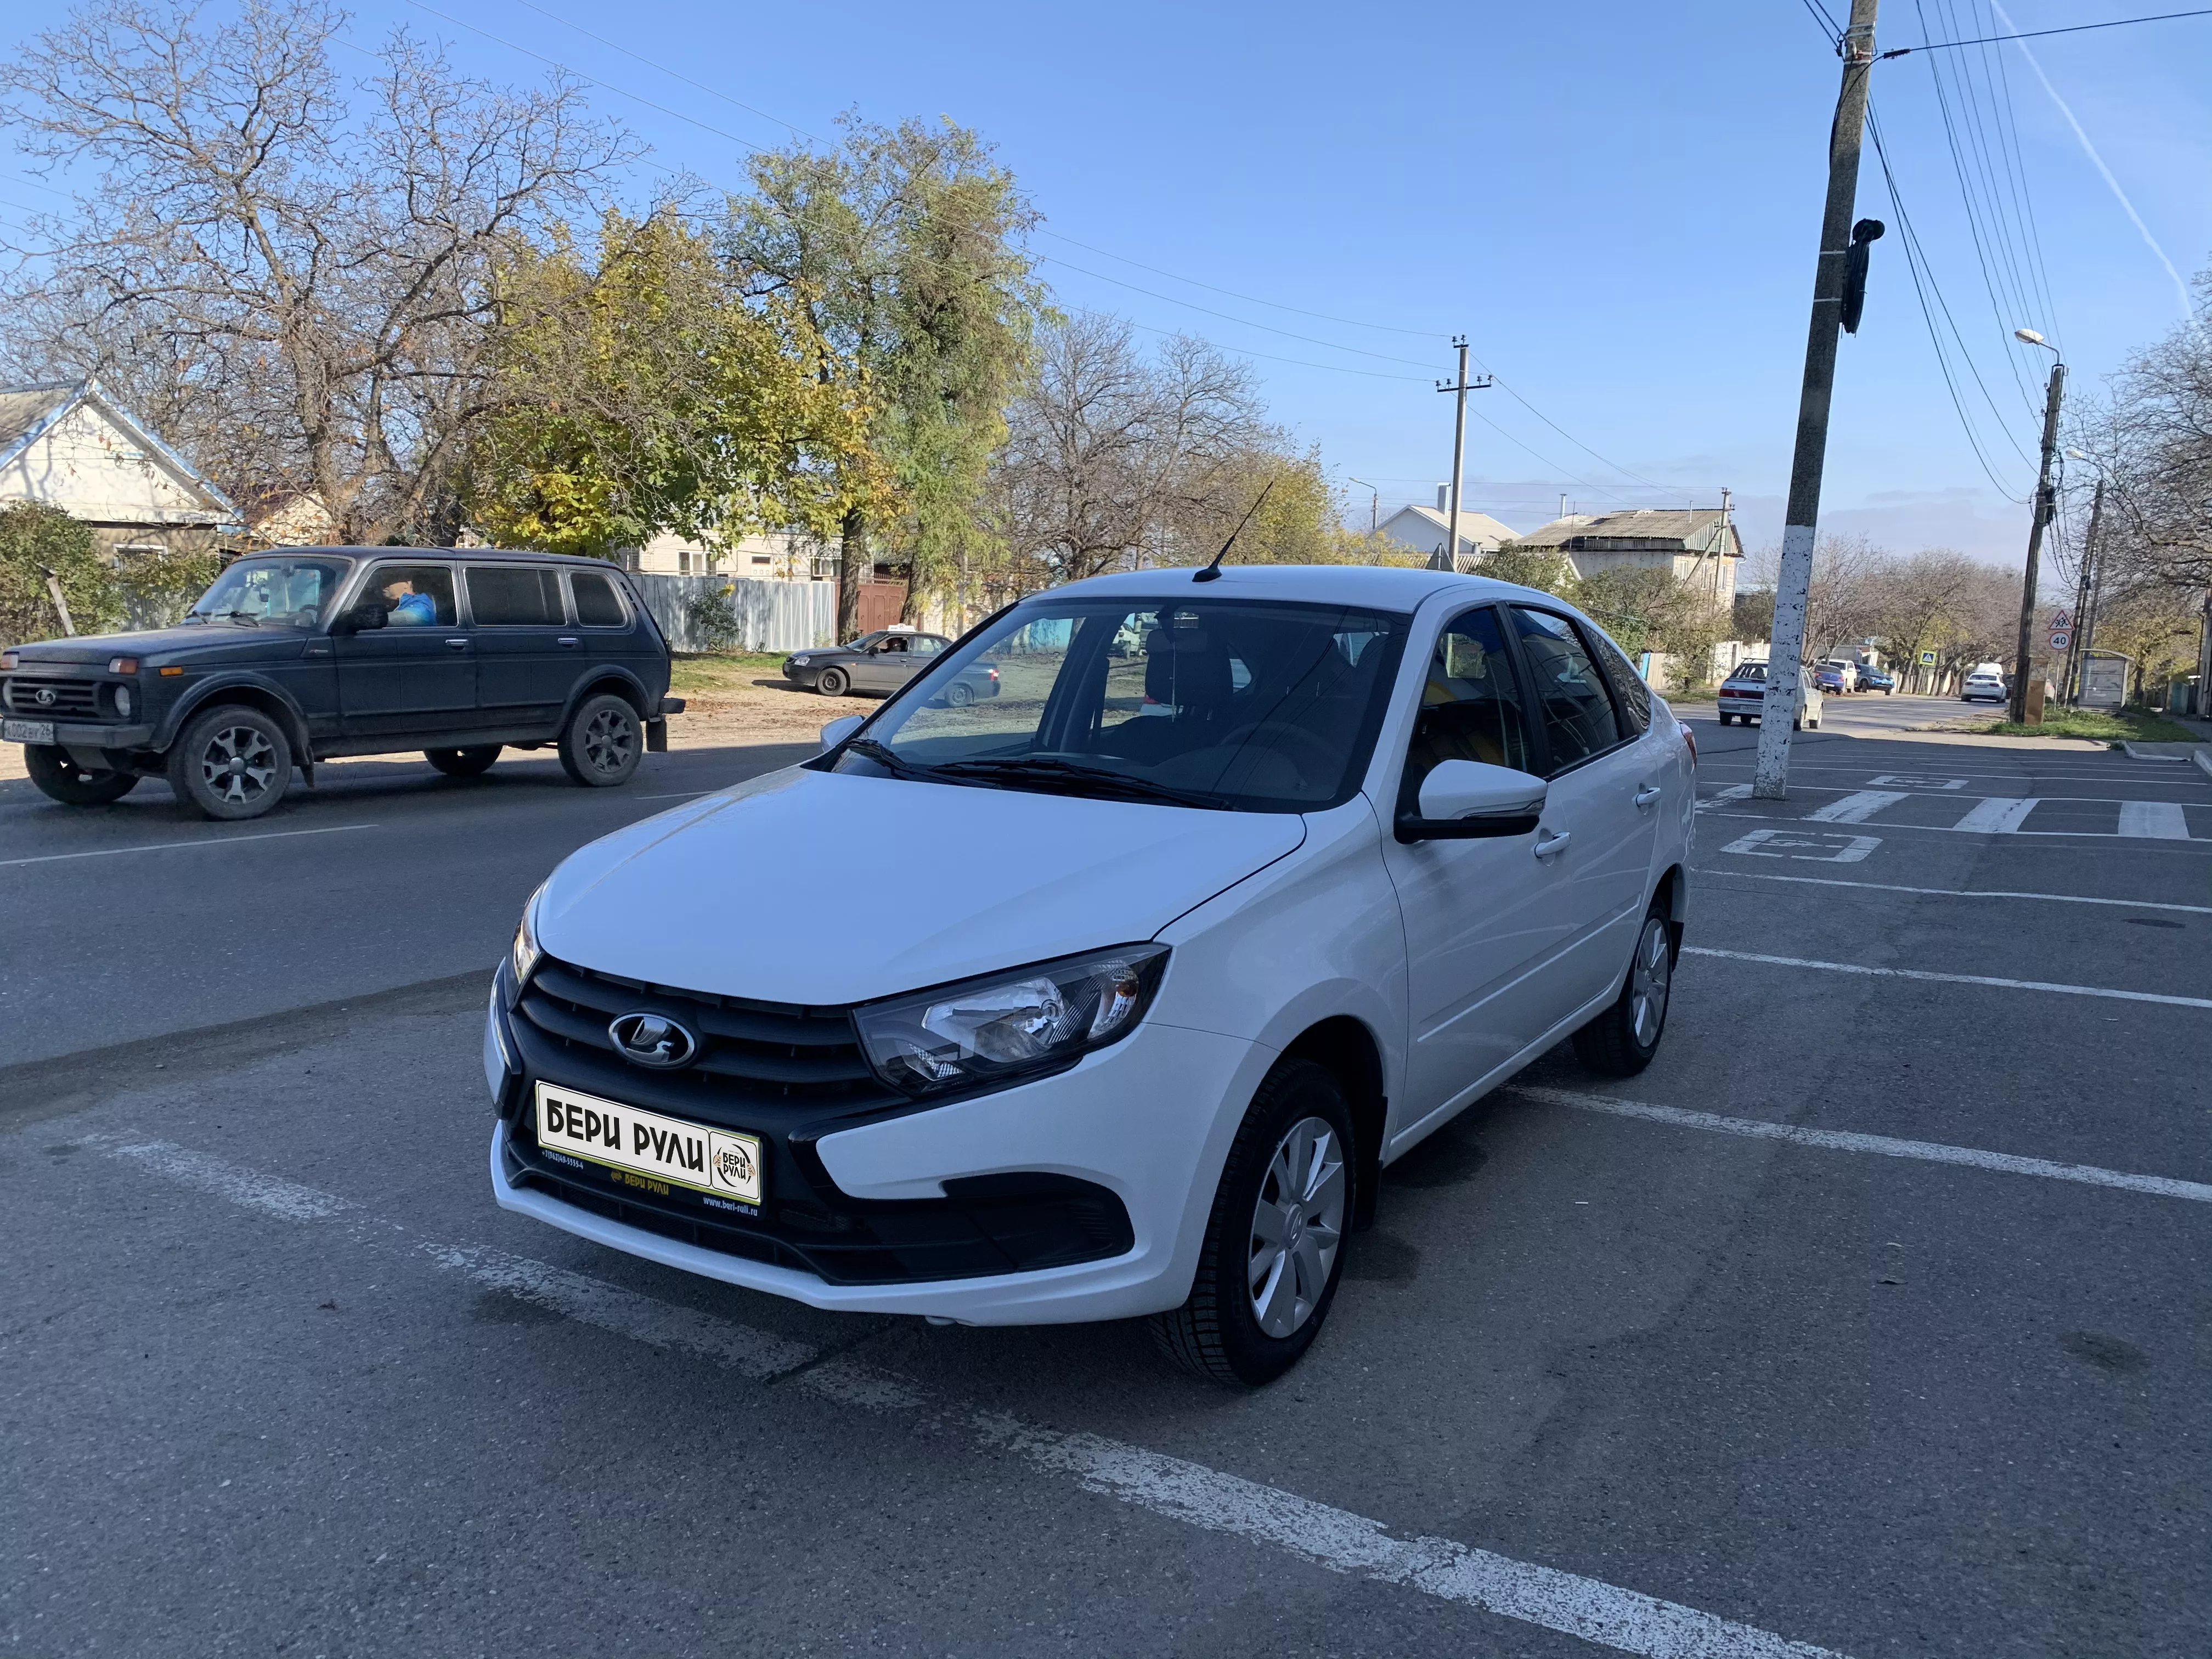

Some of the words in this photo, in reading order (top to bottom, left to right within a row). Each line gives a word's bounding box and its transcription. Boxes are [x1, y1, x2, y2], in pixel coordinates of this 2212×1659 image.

[547, 1098, 620, 1150] БЕРИ
[634, 1122, 703, 1172] РУЛИ
[723, 1152, 745, 1168] БЕРИ
[724, 1163, 746, 1180] РУЛИ
[625, 1173, 645, 1189] БЕРИ
[647, 1180, 669, 1195] РУЛИ
